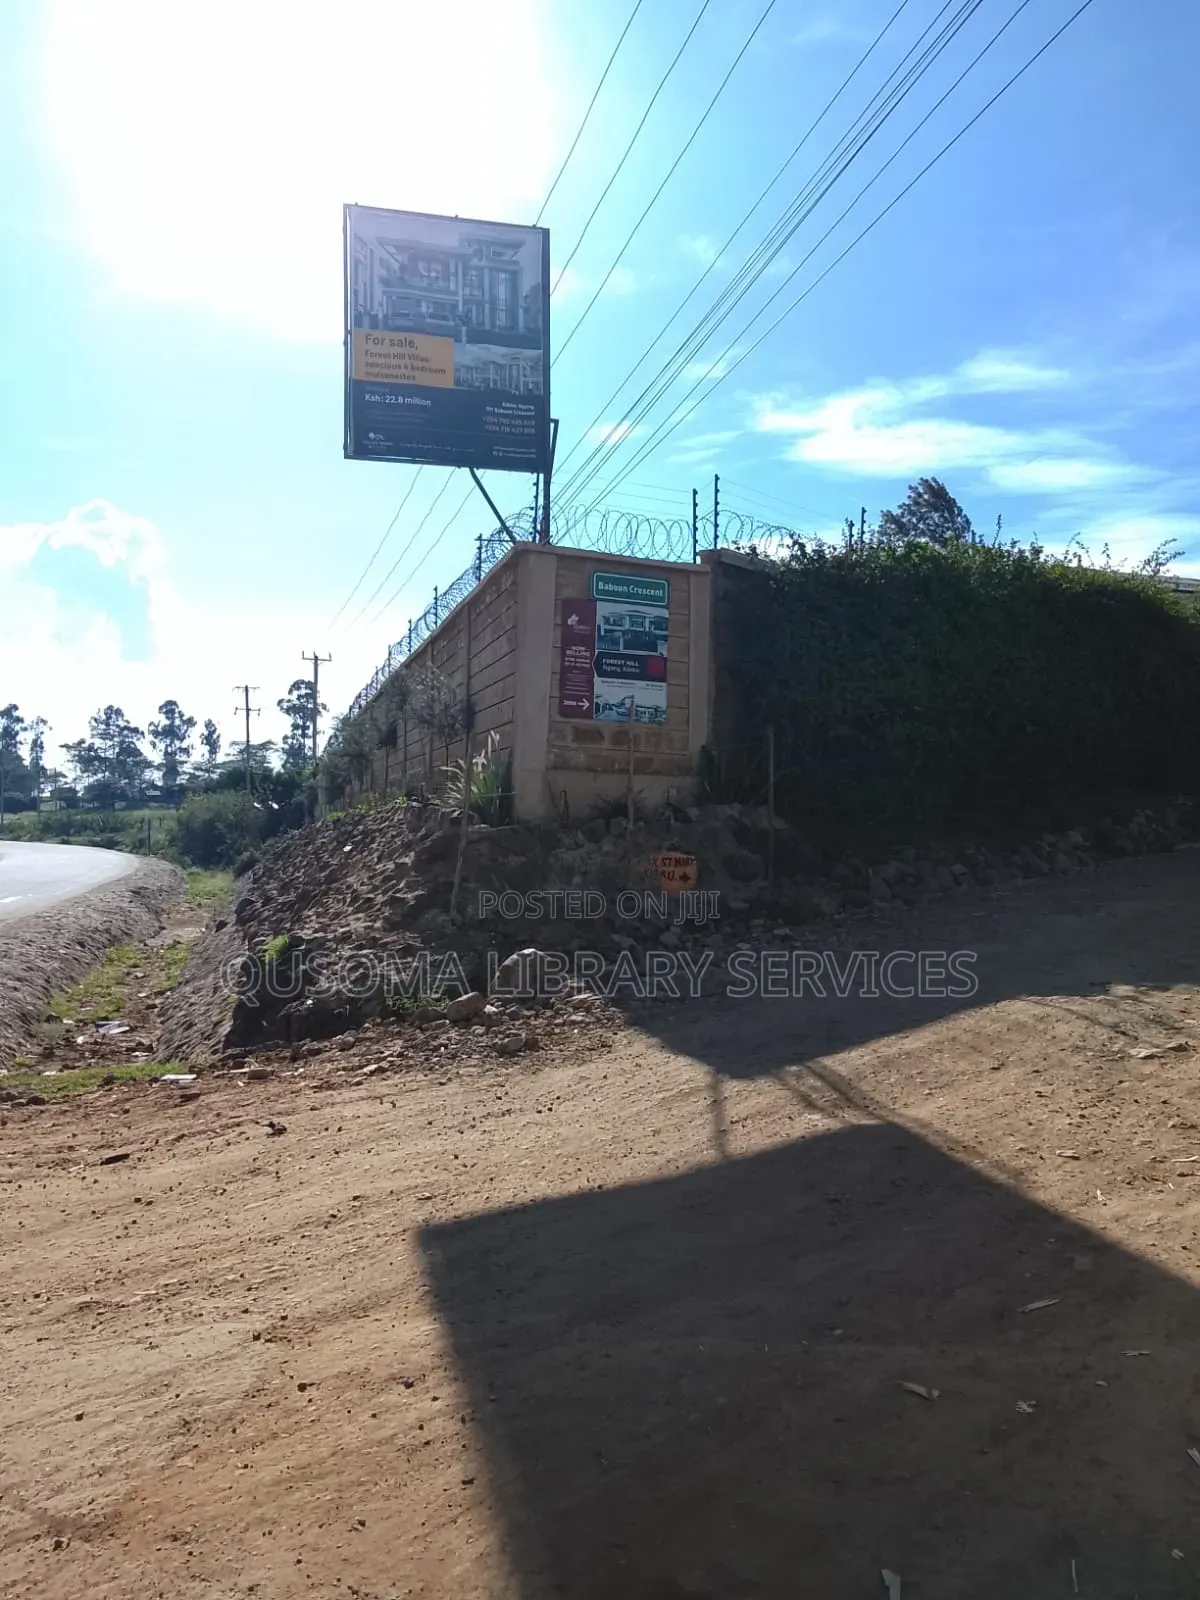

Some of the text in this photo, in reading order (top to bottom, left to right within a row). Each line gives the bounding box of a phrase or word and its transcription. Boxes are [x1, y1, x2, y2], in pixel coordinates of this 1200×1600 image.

[365, 333, 418, 351] For sale,
[365, 349, 391, 360] Forest
[392, 352, 406, 361] Hill
[410, 364, 447, 375] bedroom
[365, 393, 384, 401] Ksh:
[404, 397, 432, 407] million
[598, 581, 663, 597] Baboon Crescent
